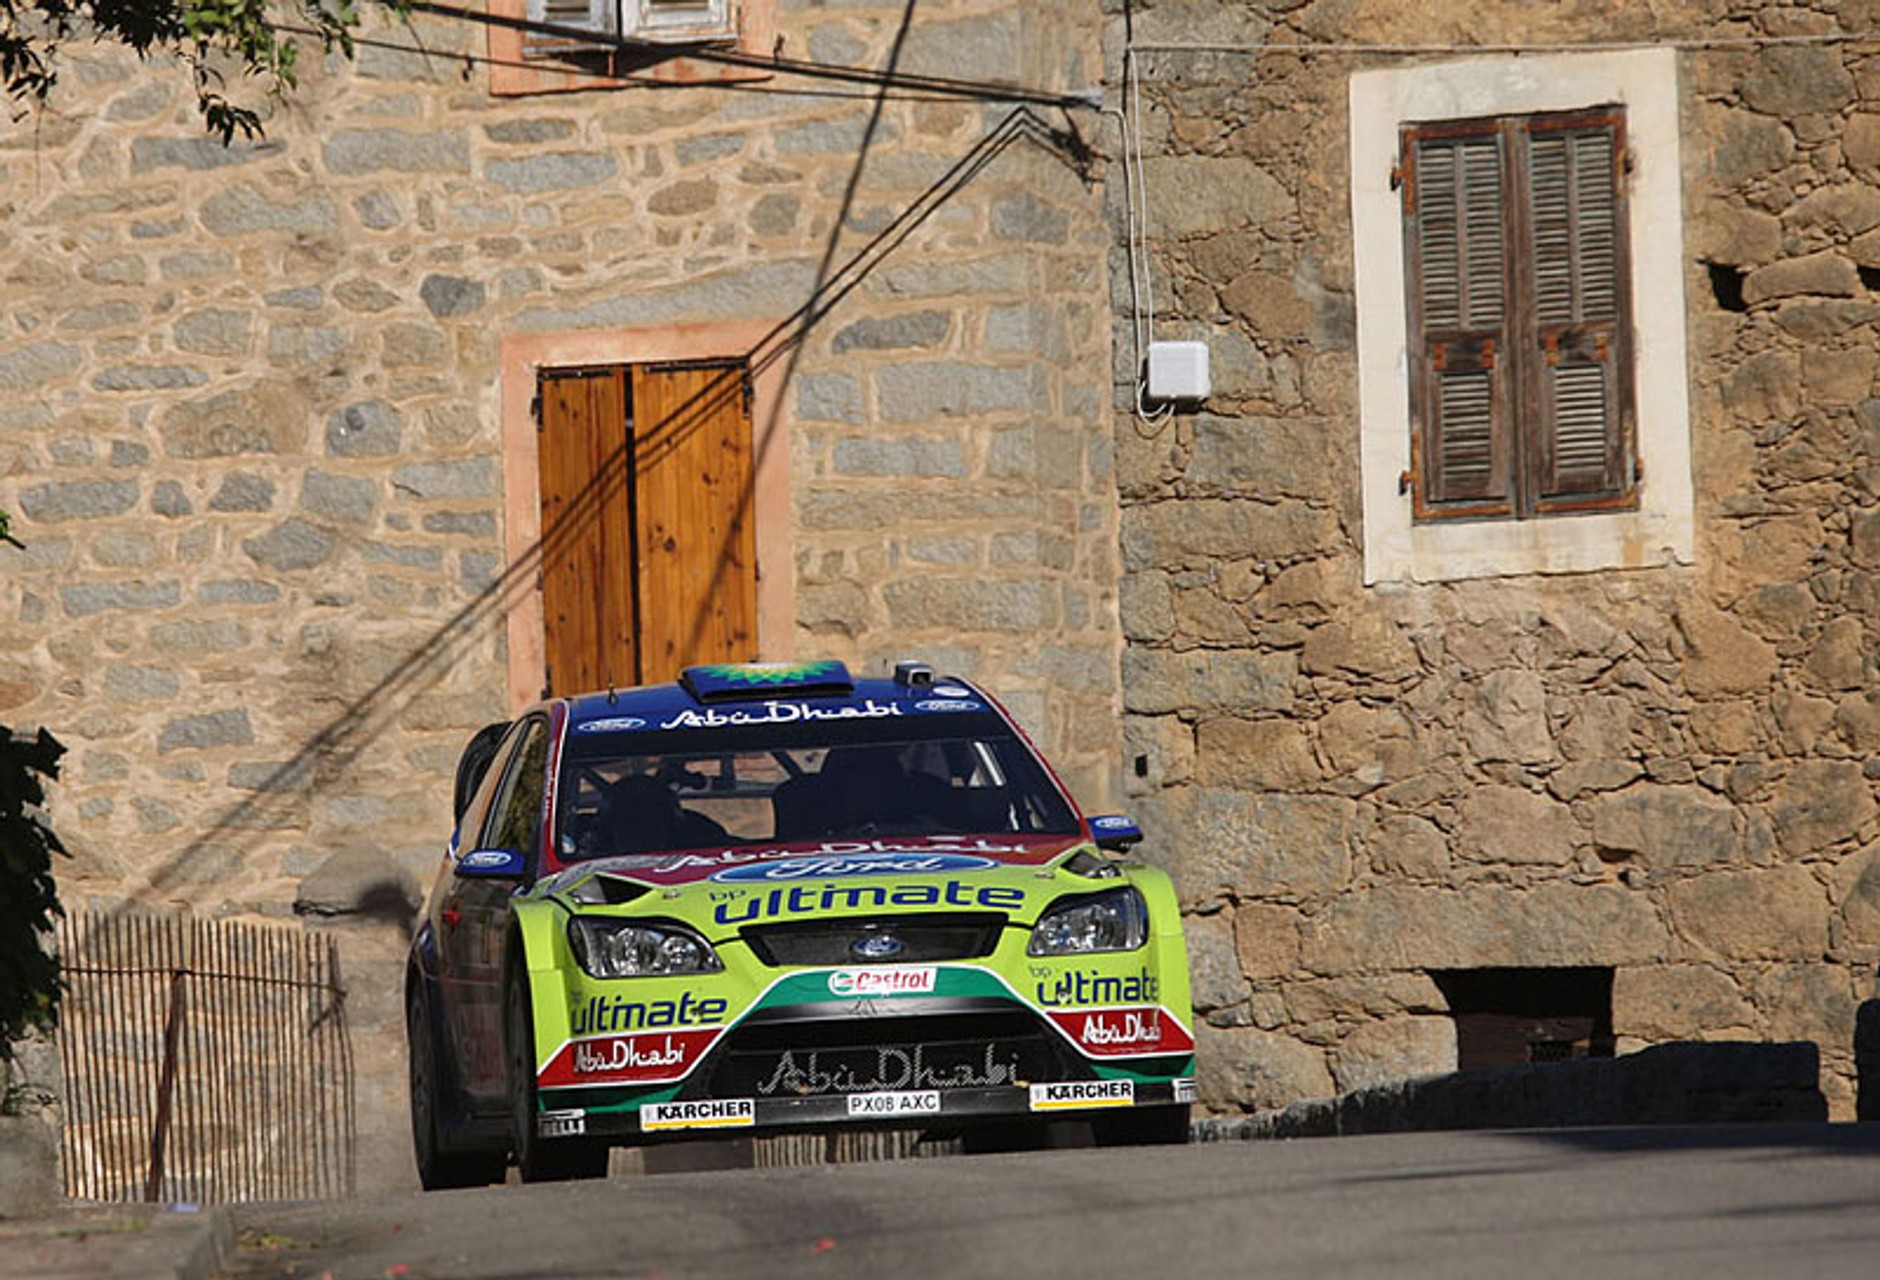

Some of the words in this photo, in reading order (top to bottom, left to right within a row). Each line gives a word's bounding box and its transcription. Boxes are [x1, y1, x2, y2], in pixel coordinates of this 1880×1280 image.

[766, 857, 945, 877] Ford
[714, 881, 1025, 925] ultimate
[856, 970, 929, 991] Castrol
[571, 991, 727, 1035] ultimate
[899, 1094, 937, 1110] AXC
